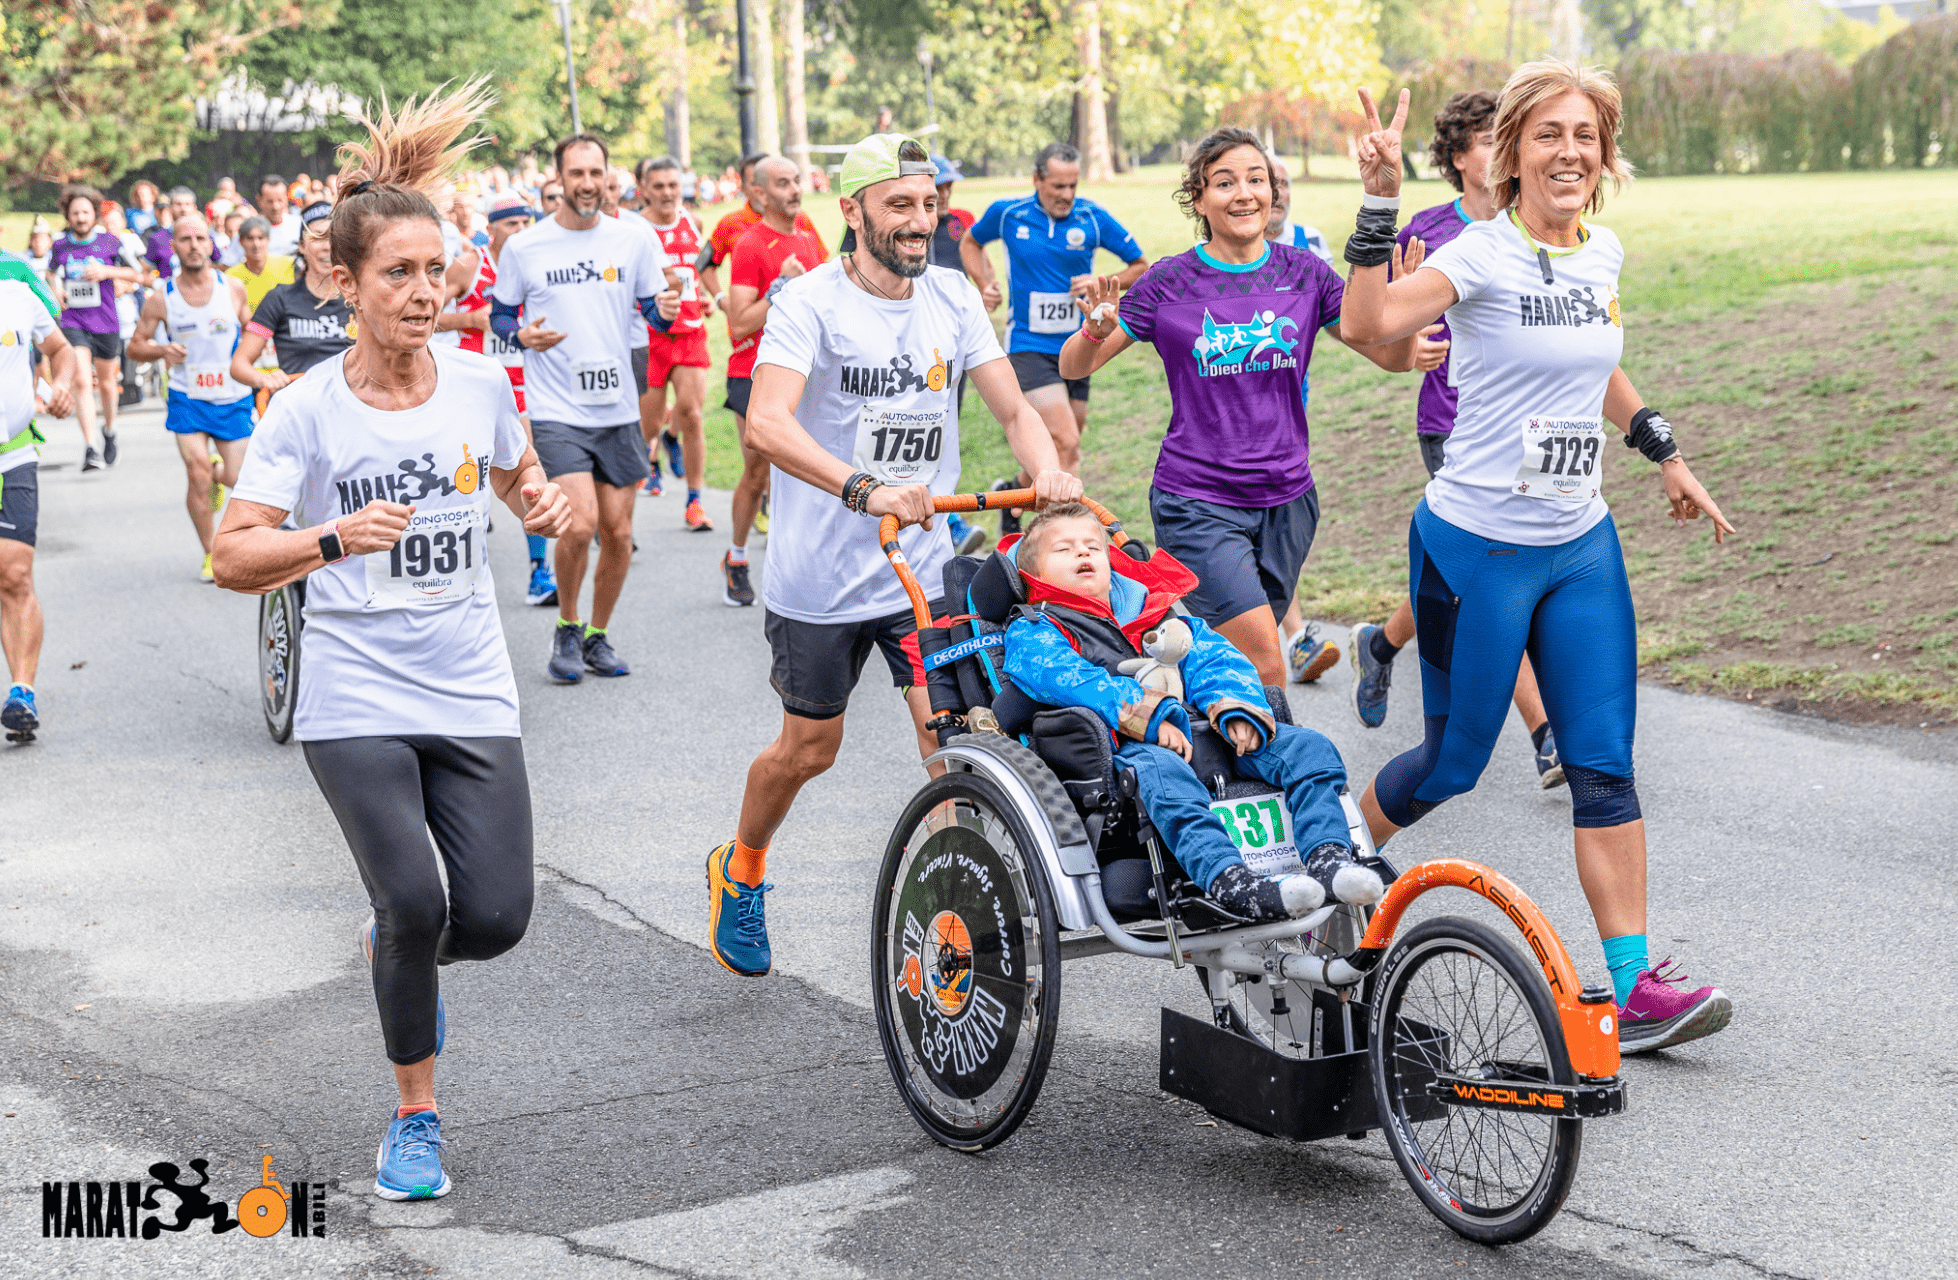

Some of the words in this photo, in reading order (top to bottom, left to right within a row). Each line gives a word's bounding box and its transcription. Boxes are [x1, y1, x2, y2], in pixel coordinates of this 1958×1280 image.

[1039, 302, 1076, 321] 1251
[1520, 294, 1621, 327] MARATO
[577, 366, 620, 390] 1795
[1245, 359, 1271, 373] che
[196, 372, 223, 388] 404
[871, 426, 943, 462] 1750
[1538, 436, 1600, 477] 1723
[888, 464, 919, 475] equilibra
[412, 510, 463, 526] OINGROS
[389, 526, 473, 578] 1931
[412, 577, 453, 590] equilibra
[933, 634, 1004, 666] DECATHLON
[1248, 846, 1290, 861] TOINGROS
[1468, 875, 1564, 995] ASSIST
[1371, 944, 1410, 1036] SCHWALBE
